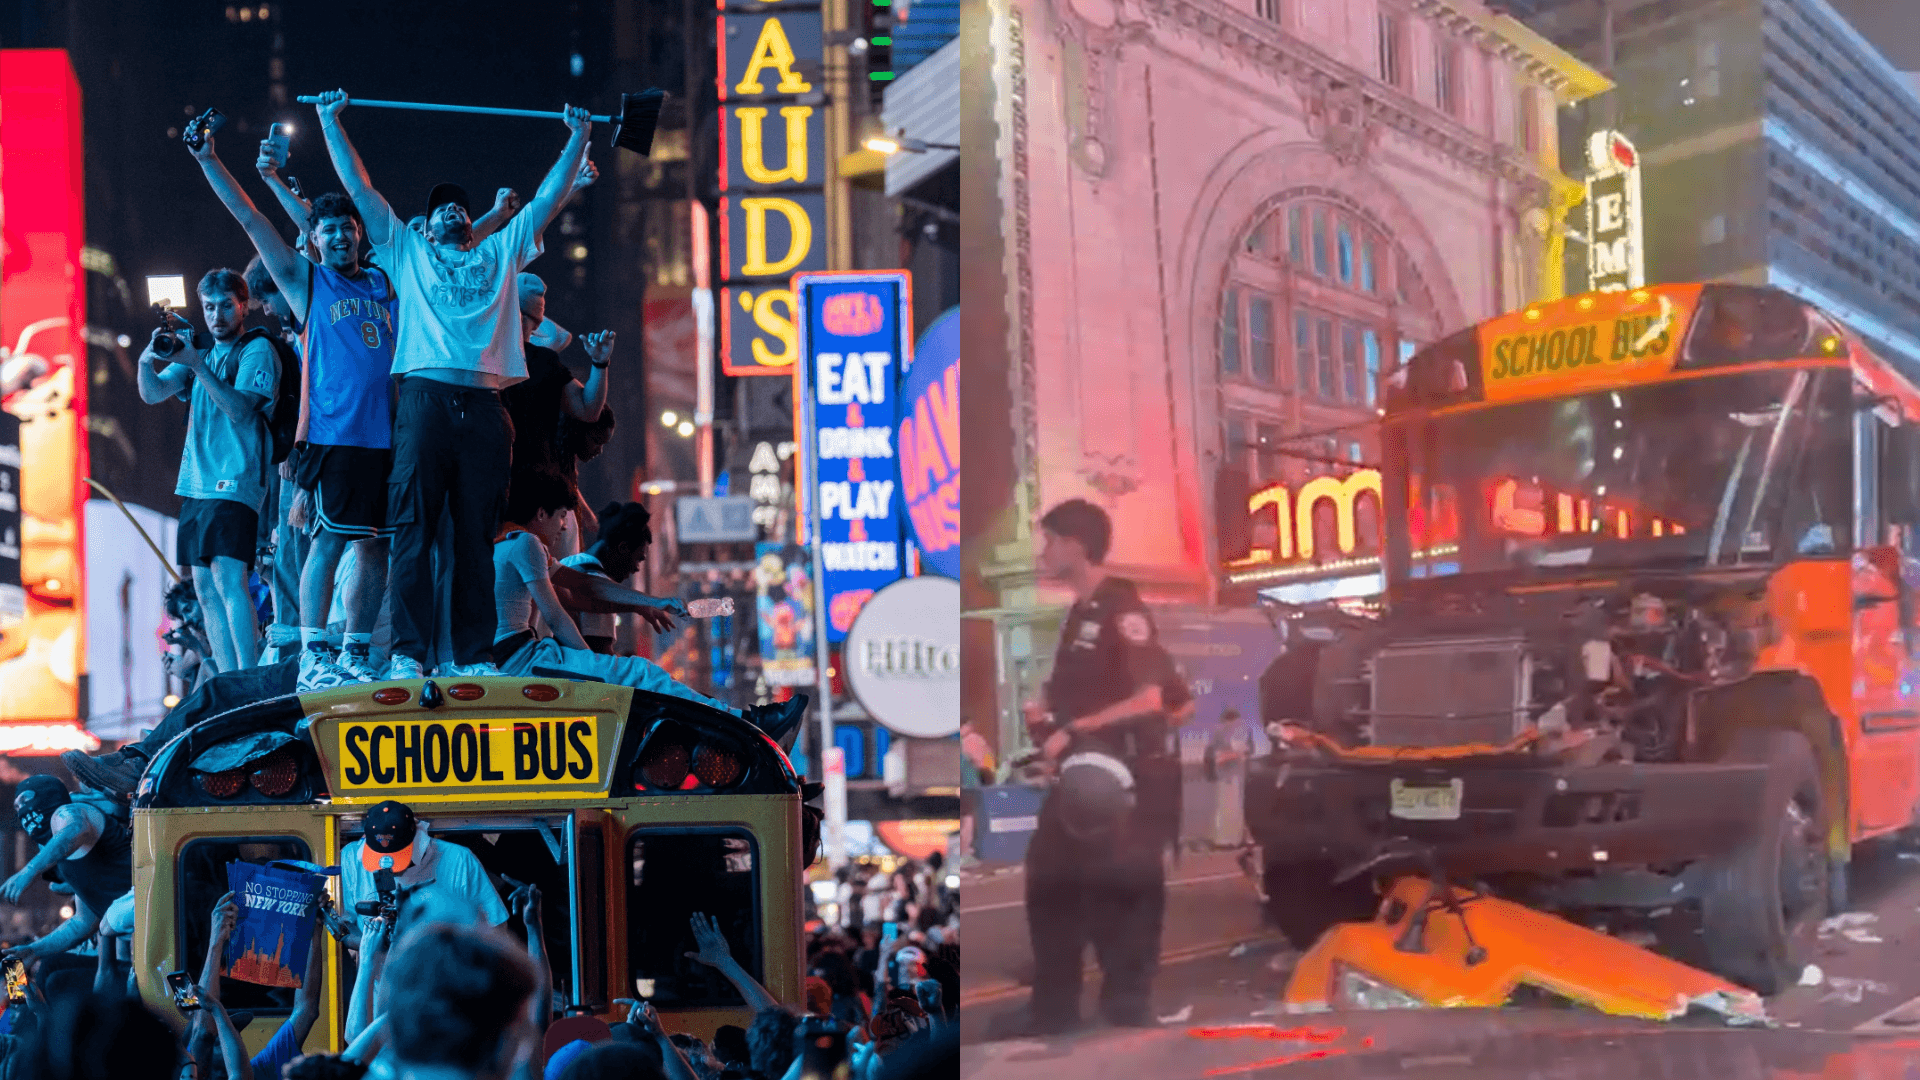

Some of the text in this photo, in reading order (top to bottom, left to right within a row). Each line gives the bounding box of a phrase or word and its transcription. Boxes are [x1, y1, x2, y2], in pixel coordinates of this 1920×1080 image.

[735, 0, 813, 366] AUD'S
[1594, 191, 1630, 293] EM
[330, 298, 391, 325] NEW YO
[361, 320, 381, 349] 8
[1492, 314, 1673, 379] SCHOOL BUS
[816, 352, 891, 405] EAT
[818, 426, 893, 459] DRINK
[898, 357, 960, 503] AV
[819, 480, 894, 520] PLAY
[822, 541, 897, 571] WATCH
[344, 721, 593, 786] SCHOOL BUS
[245, 881, 314, 904] NO STOPPING
[245, 893, 309, 917] NEW YORK
